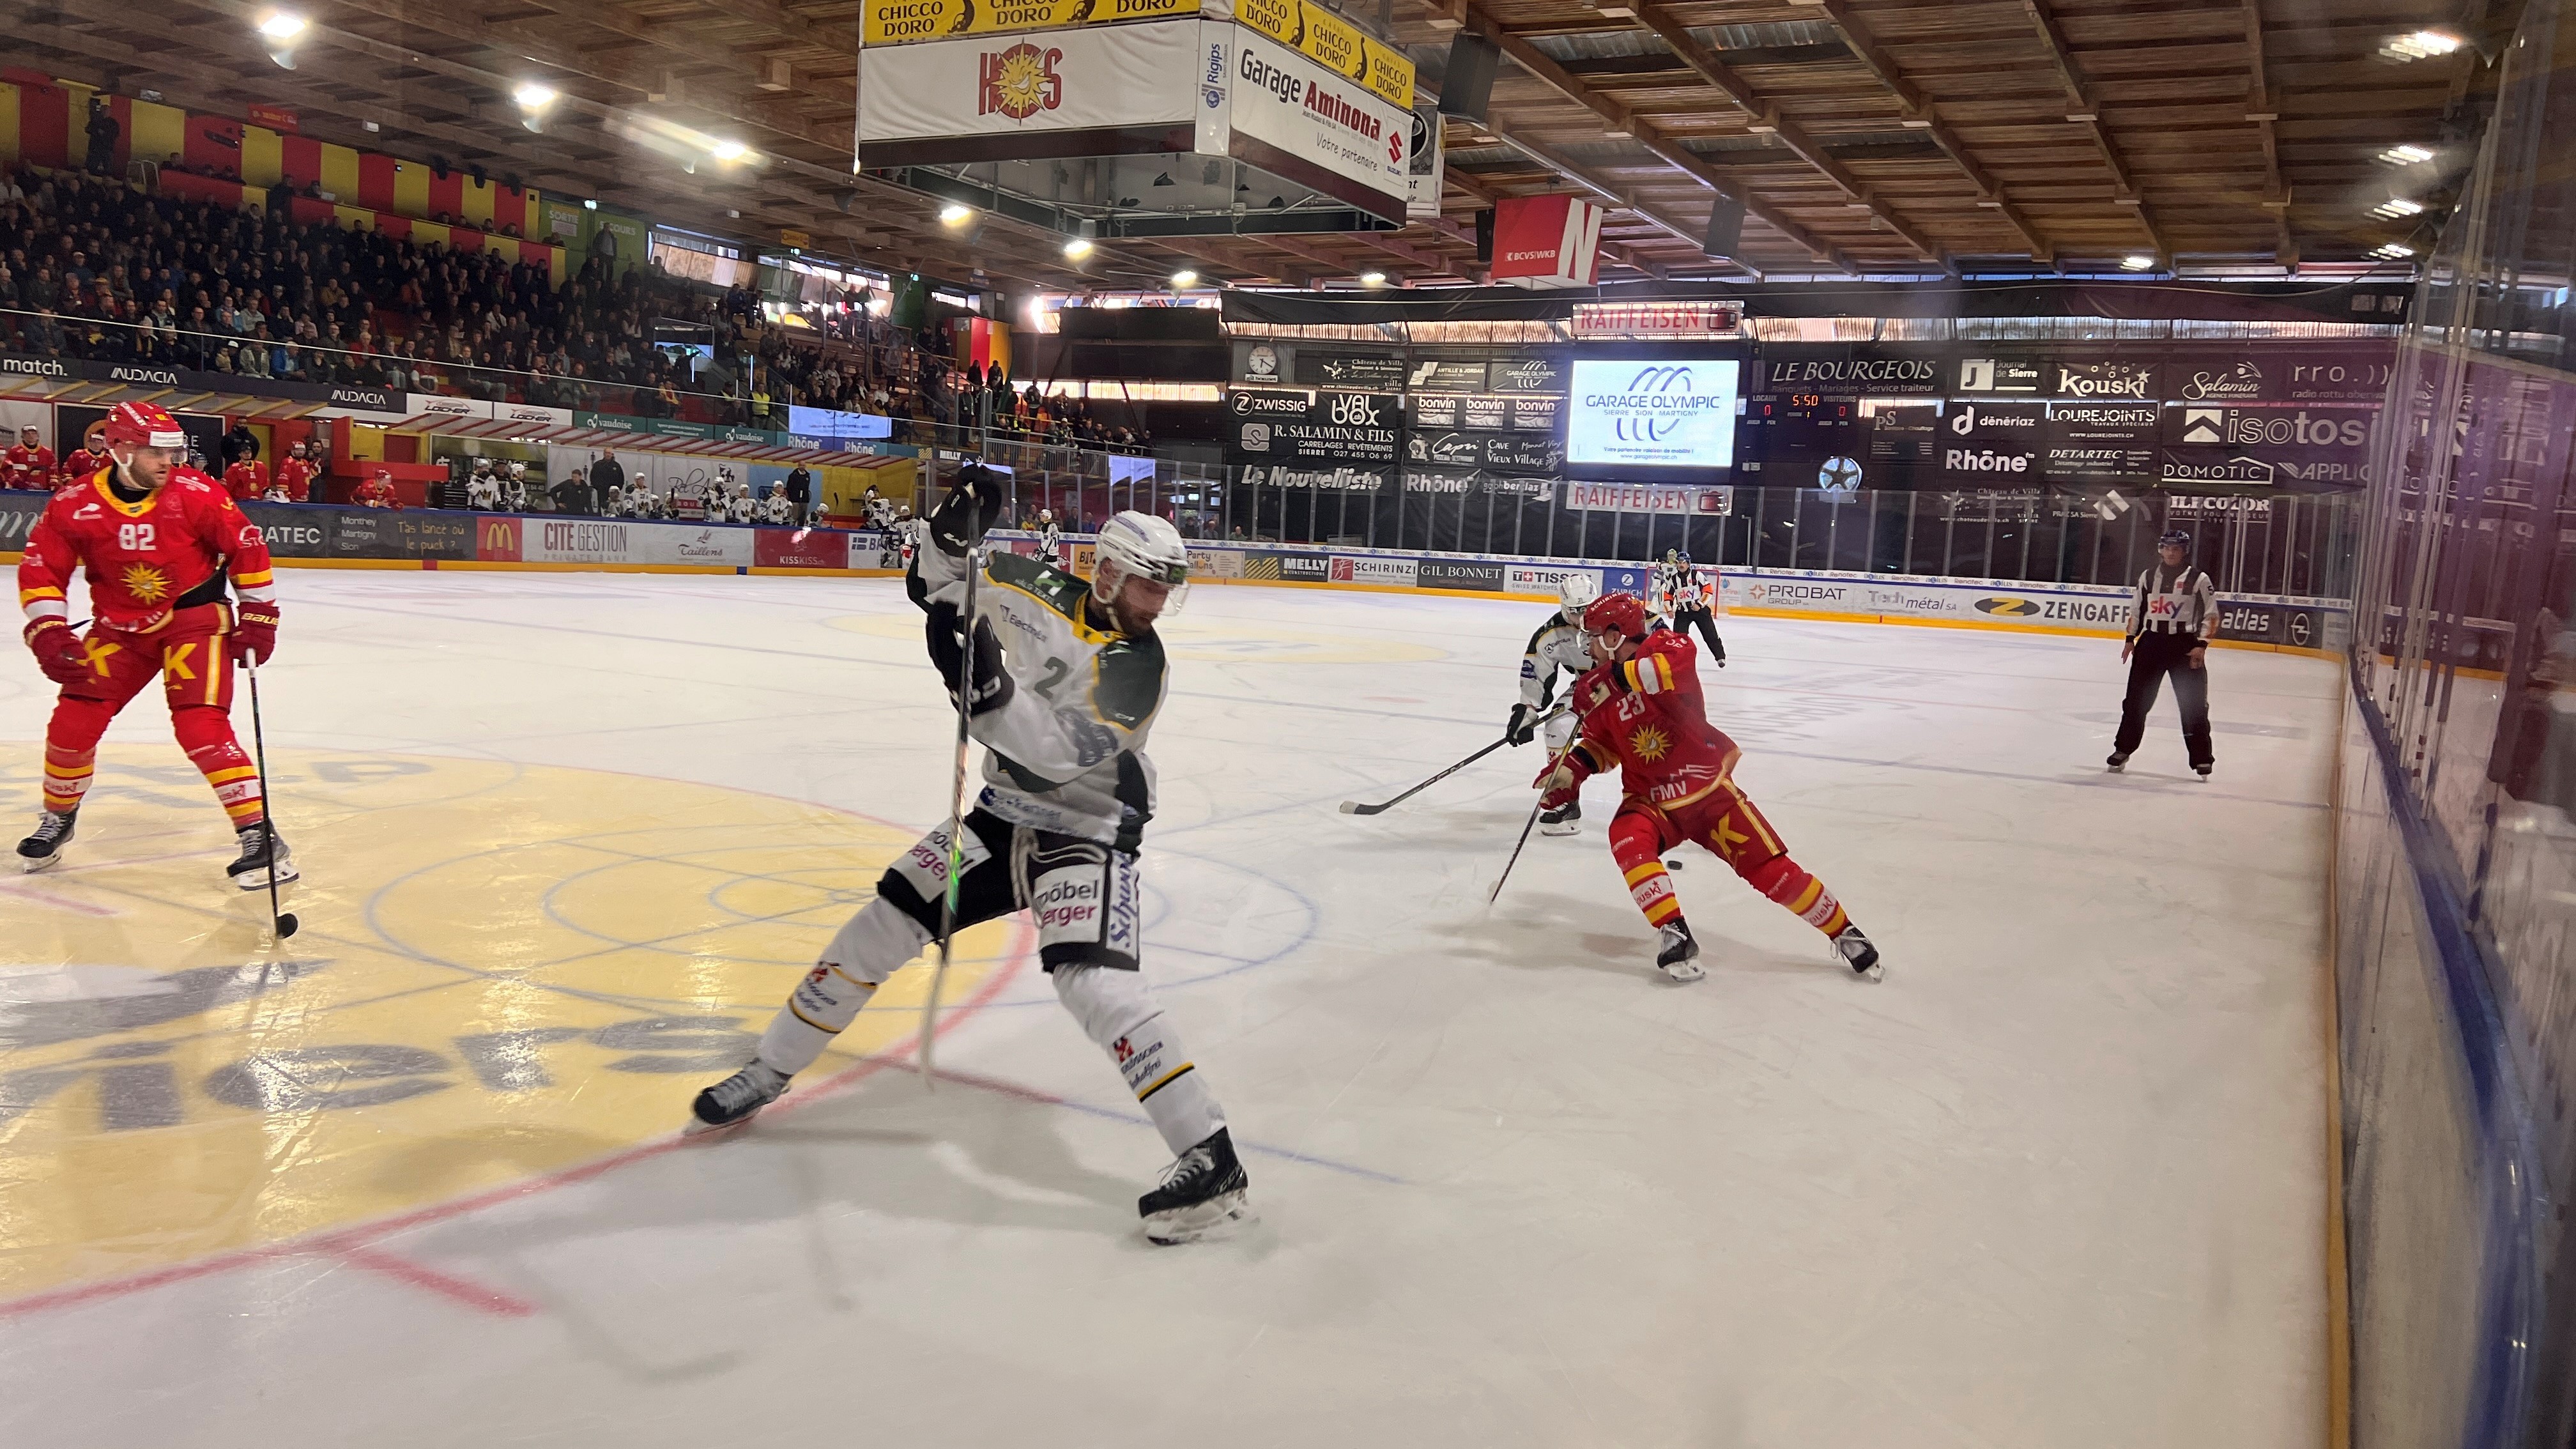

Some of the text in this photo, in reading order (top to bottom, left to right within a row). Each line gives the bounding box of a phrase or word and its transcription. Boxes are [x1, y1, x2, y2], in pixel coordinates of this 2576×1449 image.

[878, 1, 943, 20] CHICCO
[997, 6, 1052, 25] D'ORO
[1246, 4, 1282, 34] D'ORO
[884, 19, 935, 36] D'ORO
[1314, 24, 1351, 55] CHICCO
[1208, 43, 1222, 84] Rigips
[1315, 42, 1346, 68] D'ORO
[1374, 57, 1407, 86] CHICCO
[1241, 49, 1301, 103] Garage
[1304, 80, 1381, 141] Aminona
[1376, 74, 1402, 100] D'ORO
[1317, 132, 1338, 154] Votre
[1341, 146, 1378, 172] partenaire
[600, 220, 636, 236] SCOURS
[1580, 307, 1699, 330] RAIFFEISEN
[3, 358, 68, 376] match.
[1772, 360, 1936, 382] LE BOURGEOIS
[1996, 360, 2027, 369] Journal
[1996, 368, 2038, 378] de Sierre
[111, 367, 178, 385] AUDACIA
[2057, 369, 2149, 399] Kouski
[1772, 383, 1935, 394] Banquets Mariages Service traiteur
[2182, 371, 2262, 401] Salamin
[2292, 390, 2386, 399] radio rottu oberwa
[331, 389, 387, 406] AUDACIA
[1255, 399, 1306, 413] ZWISSIG
[1418, 396, 1456, 409] bonvin
[1466, 397, 1505, 410] bonvin
[1515, 399, 1555, 411] bonvin
[1586, 395, 1720, 409] GARAGE OLYMPIC
[1823, 395, 1856, 403] VISITEURS
[598, 418, 632, 430] vaudoise
[2051, 409, 2156, 422] LOUREJOINTS
[1274, 425, 1394, 443] R. SALAMIN & FILS
[2228, 410, 2365, 446] isotos
[735, 433, 764, 443] vaudoise
[1298, 440, 1344, 448] CARRELAGES
[2049, 449, 2123, 459] DETARTEC
[1241, 464, 1383, 490] Le Nouvelliste
[2163, 464, 2262, 479] DOMOTIC
[1575, 486, 1690, 510] RAIFFEISEN
[342, 516, 376, 526] Monthey
[118, 523, 157, 551] 82
[342, 529, 376, 540] Martigny
[578, 524, 627, 553] GESTION
[342, 542, 359, 551] Sion
[420, 539, 444, 556] puck
[678, 544, 723, 557] Taillens
[1187, 550, 1211, 561] Party
[1284, 558, 1328, 571] MELLY
[1354, 562, 1416, 574] SCHIRINZI
[1421, 565, 1502, 579] GIL BONNET
[1678, 590, 1695, 601] sky
[1768, 585, 1846, 601] PROBAT
[1906, 598, 1945, 611] métal
[2044, 601, 2131, 624] ZENGAFF
[2150, 595, 2182, 619] sky
[2221, 608, 2269, 632] atlas
[164, 643, 197, 682] K
[1616, 691, 1646, 723] 23
[1650, 780, 1688, 803] FMV
